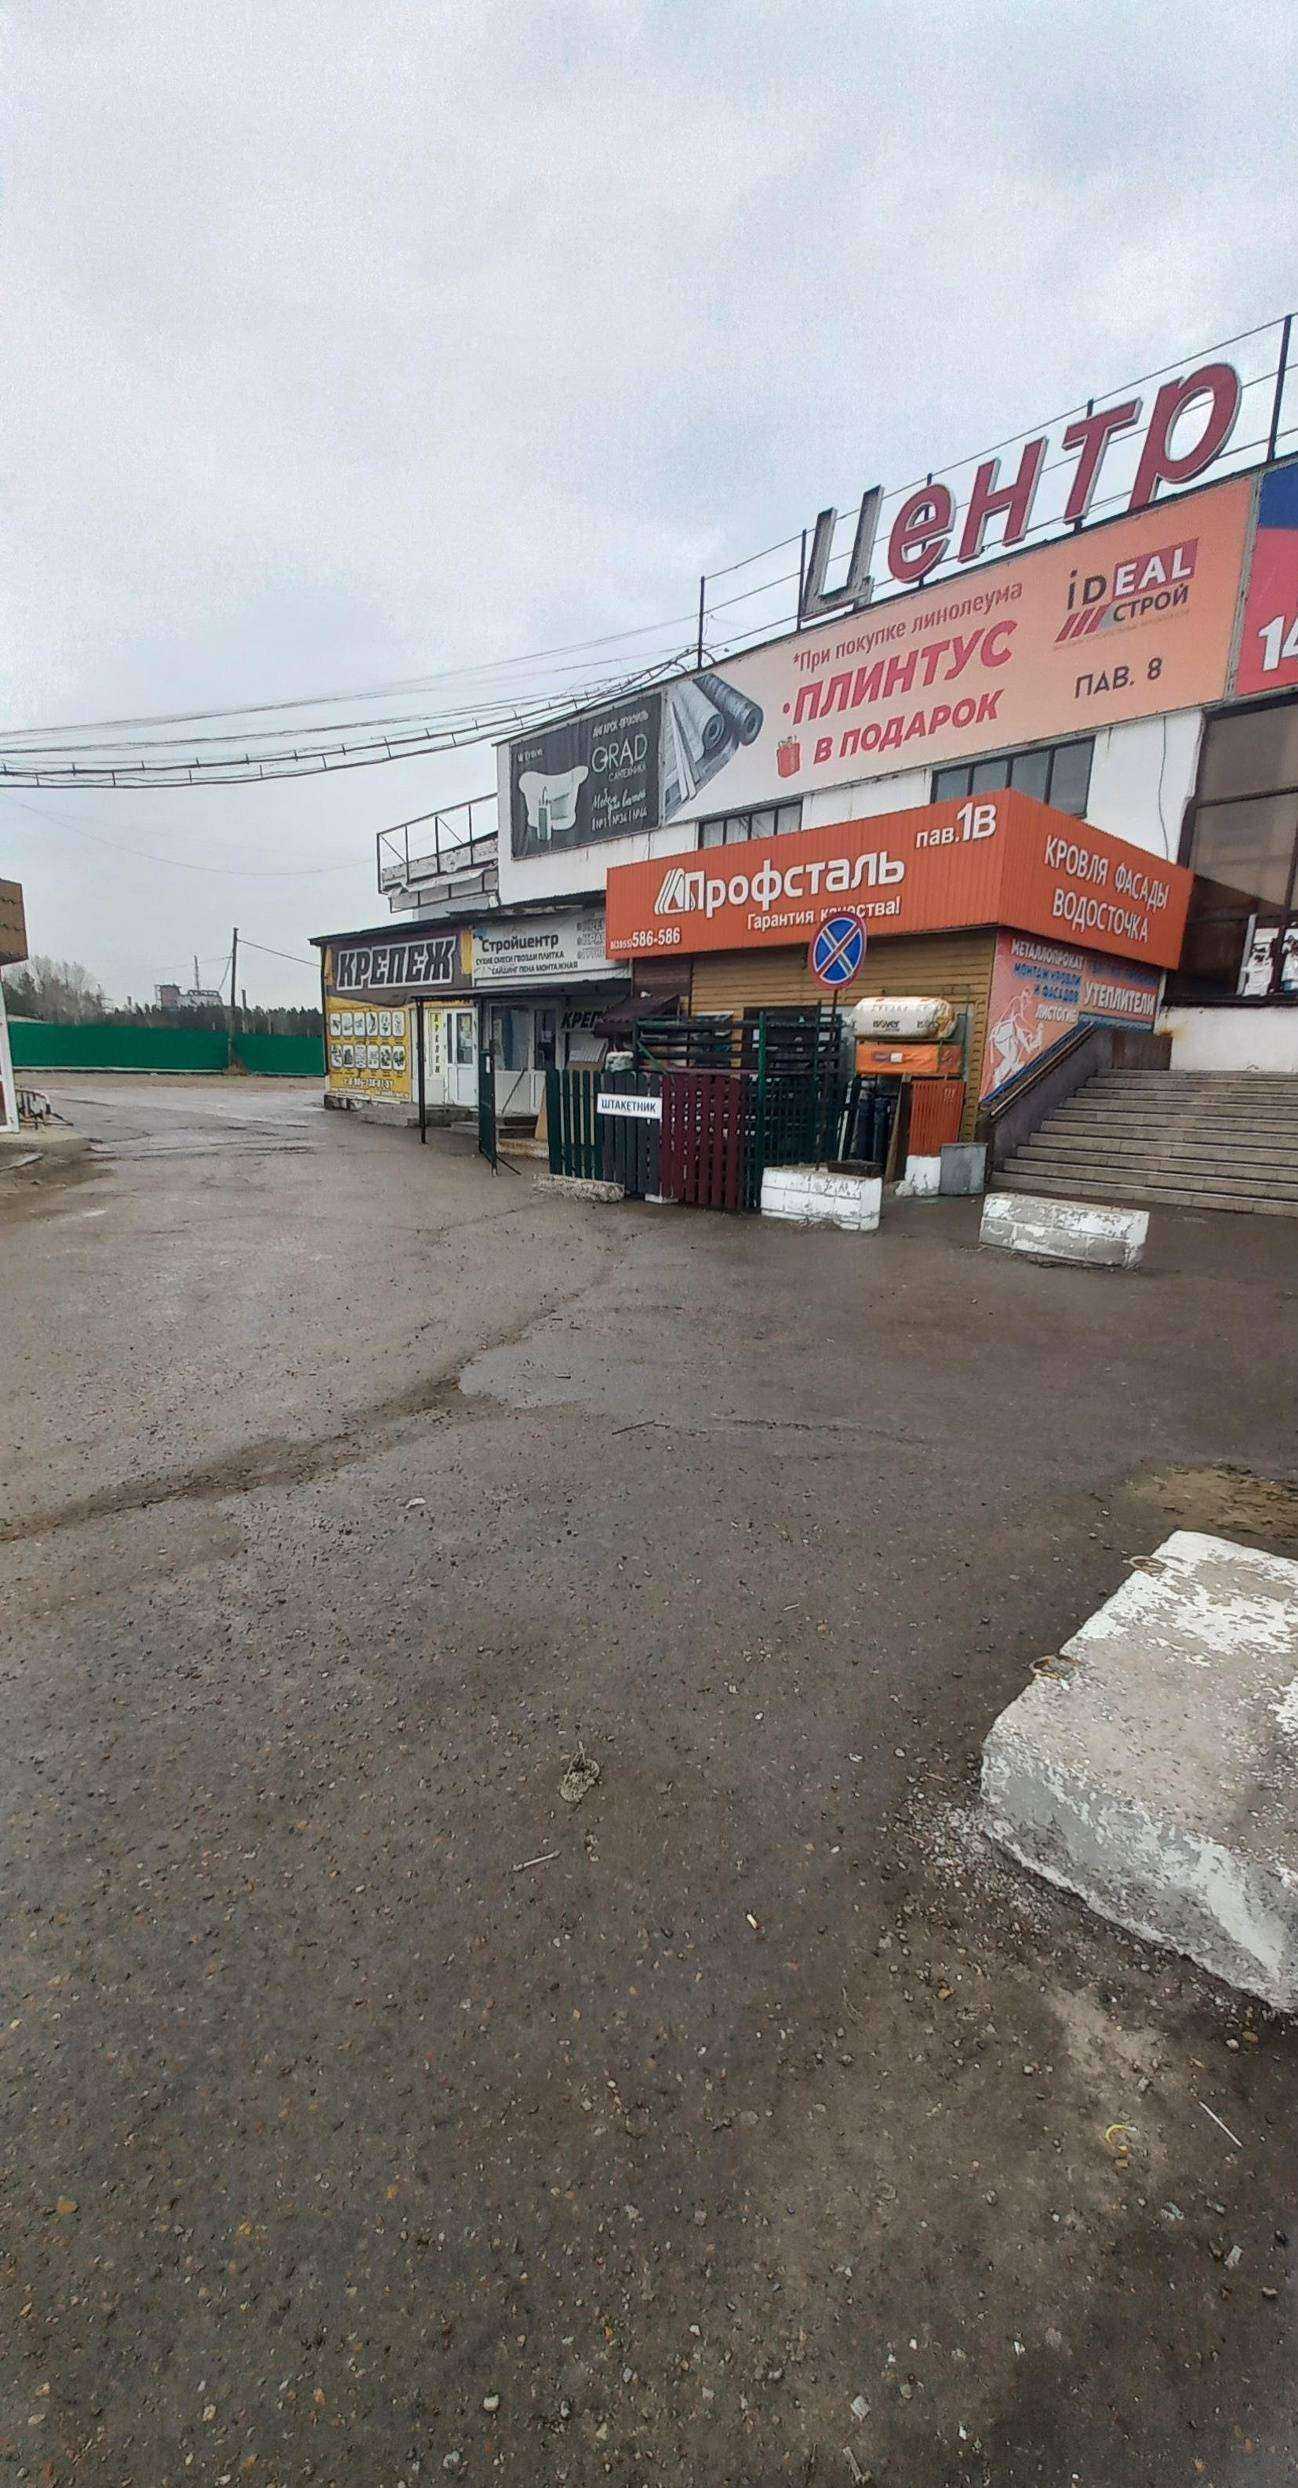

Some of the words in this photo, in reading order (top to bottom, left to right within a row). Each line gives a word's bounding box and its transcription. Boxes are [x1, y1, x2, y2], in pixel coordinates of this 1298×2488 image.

[800, 362, 1242, 621] Центр
[835, 622, 905, 659] покупке
[911, 582, 1023, 633] линолеума
[1113, 583, 1189, 621] СТРОЙ
[793, 620, 1017, 725] ПЛИНТУС
[1074, 666, 1134, 698] ПАВ.
[1147, 657, 1162, 681] 8
[813, 736, 833, 765] В
[839, 689, 1004, 759] ПОДАРОК
[592, 733, 648, 772] GRAD
[685, 851, 905, 918] Профсталь
[1044, 835, 1109, 886] КРОВЛЯ
[1114, 862, 1171, 912] ФАСАДЫ
[747, 908, 814, 932] Гарантия
[1052, 888, 1150, 943] ВОДОСТОЧКА
[337, 936, 456, 991] КРЕПЕЖ
[482, 934, 559, 954] Стройцентр
[538, 950, 565, 961] ПЛИТКА
[1084, 981, 1156, 1016] УТЕПЛИТЕЛИ
[600, 1098, 657, 1114] ШТАКЕТНИК
